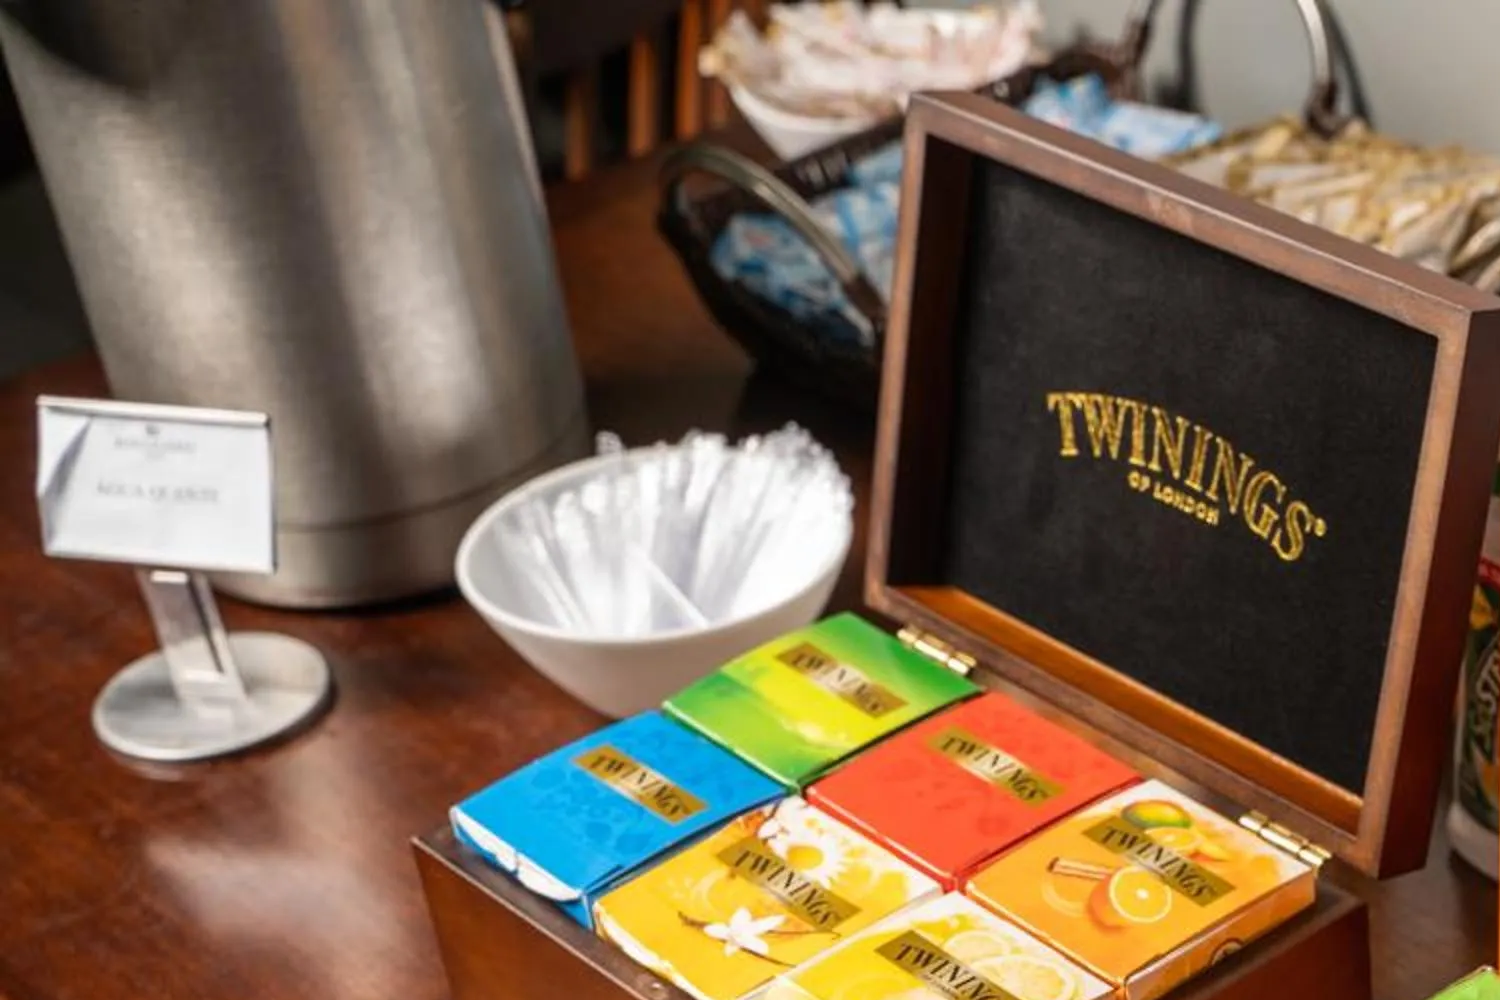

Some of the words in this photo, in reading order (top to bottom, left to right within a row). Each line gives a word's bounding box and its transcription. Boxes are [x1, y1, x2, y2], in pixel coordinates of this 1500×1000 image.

[1047, 392, 1315, 561] TWININGS
[589, 754, 693, 817] TWININGS
[942, 735, 1050, 801] TWININGS
[734, 848, 844, 927] TWININGS
[1100, 825, 1217, 899] TWININGS
